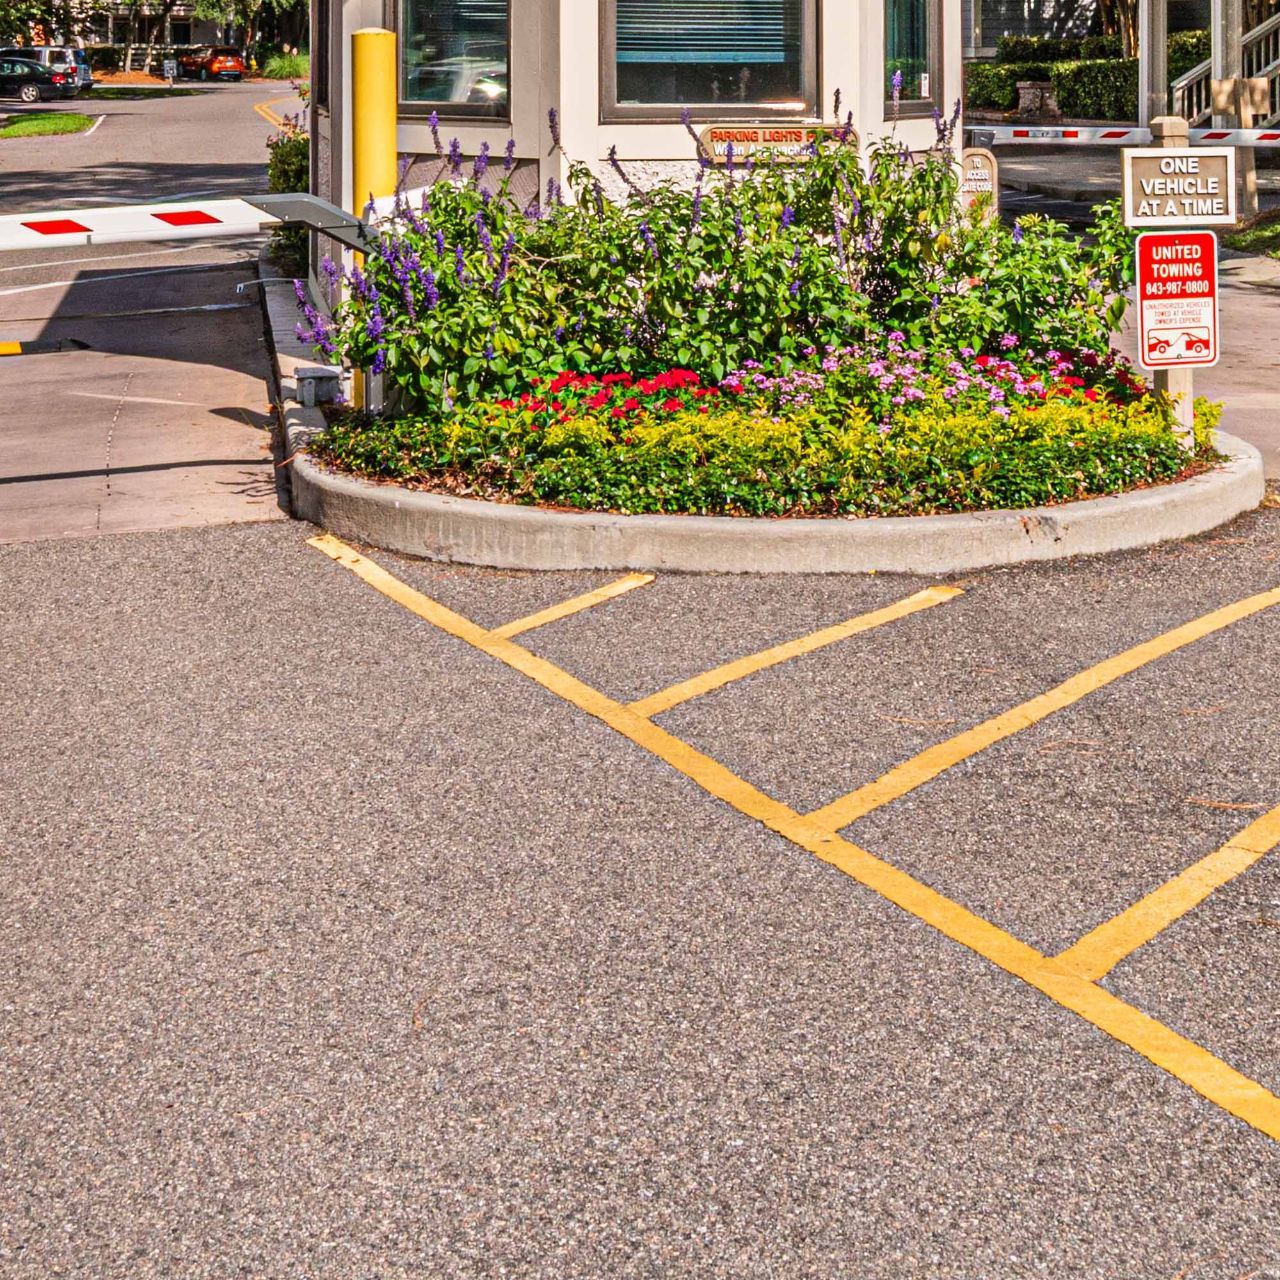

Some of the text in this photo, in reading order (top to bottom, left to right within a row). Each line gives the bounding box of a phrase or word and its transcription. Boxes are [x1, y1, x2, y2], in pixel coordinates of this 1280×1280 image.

[710, 130, 759, 143] PARKING
[763, 130, 803, 143] LIGHTS
[1160, 157, 1199, 174] ONE
[1141, 177, 1219, 195] VEHICLE
[1137, 198, 1224, 216] AT A TIME
[1152, 245, 1201, 260] UNITED
[1151, 263, 1202, 278] TOWING
[1145, 280, 1209, 295] 843-987-0800
